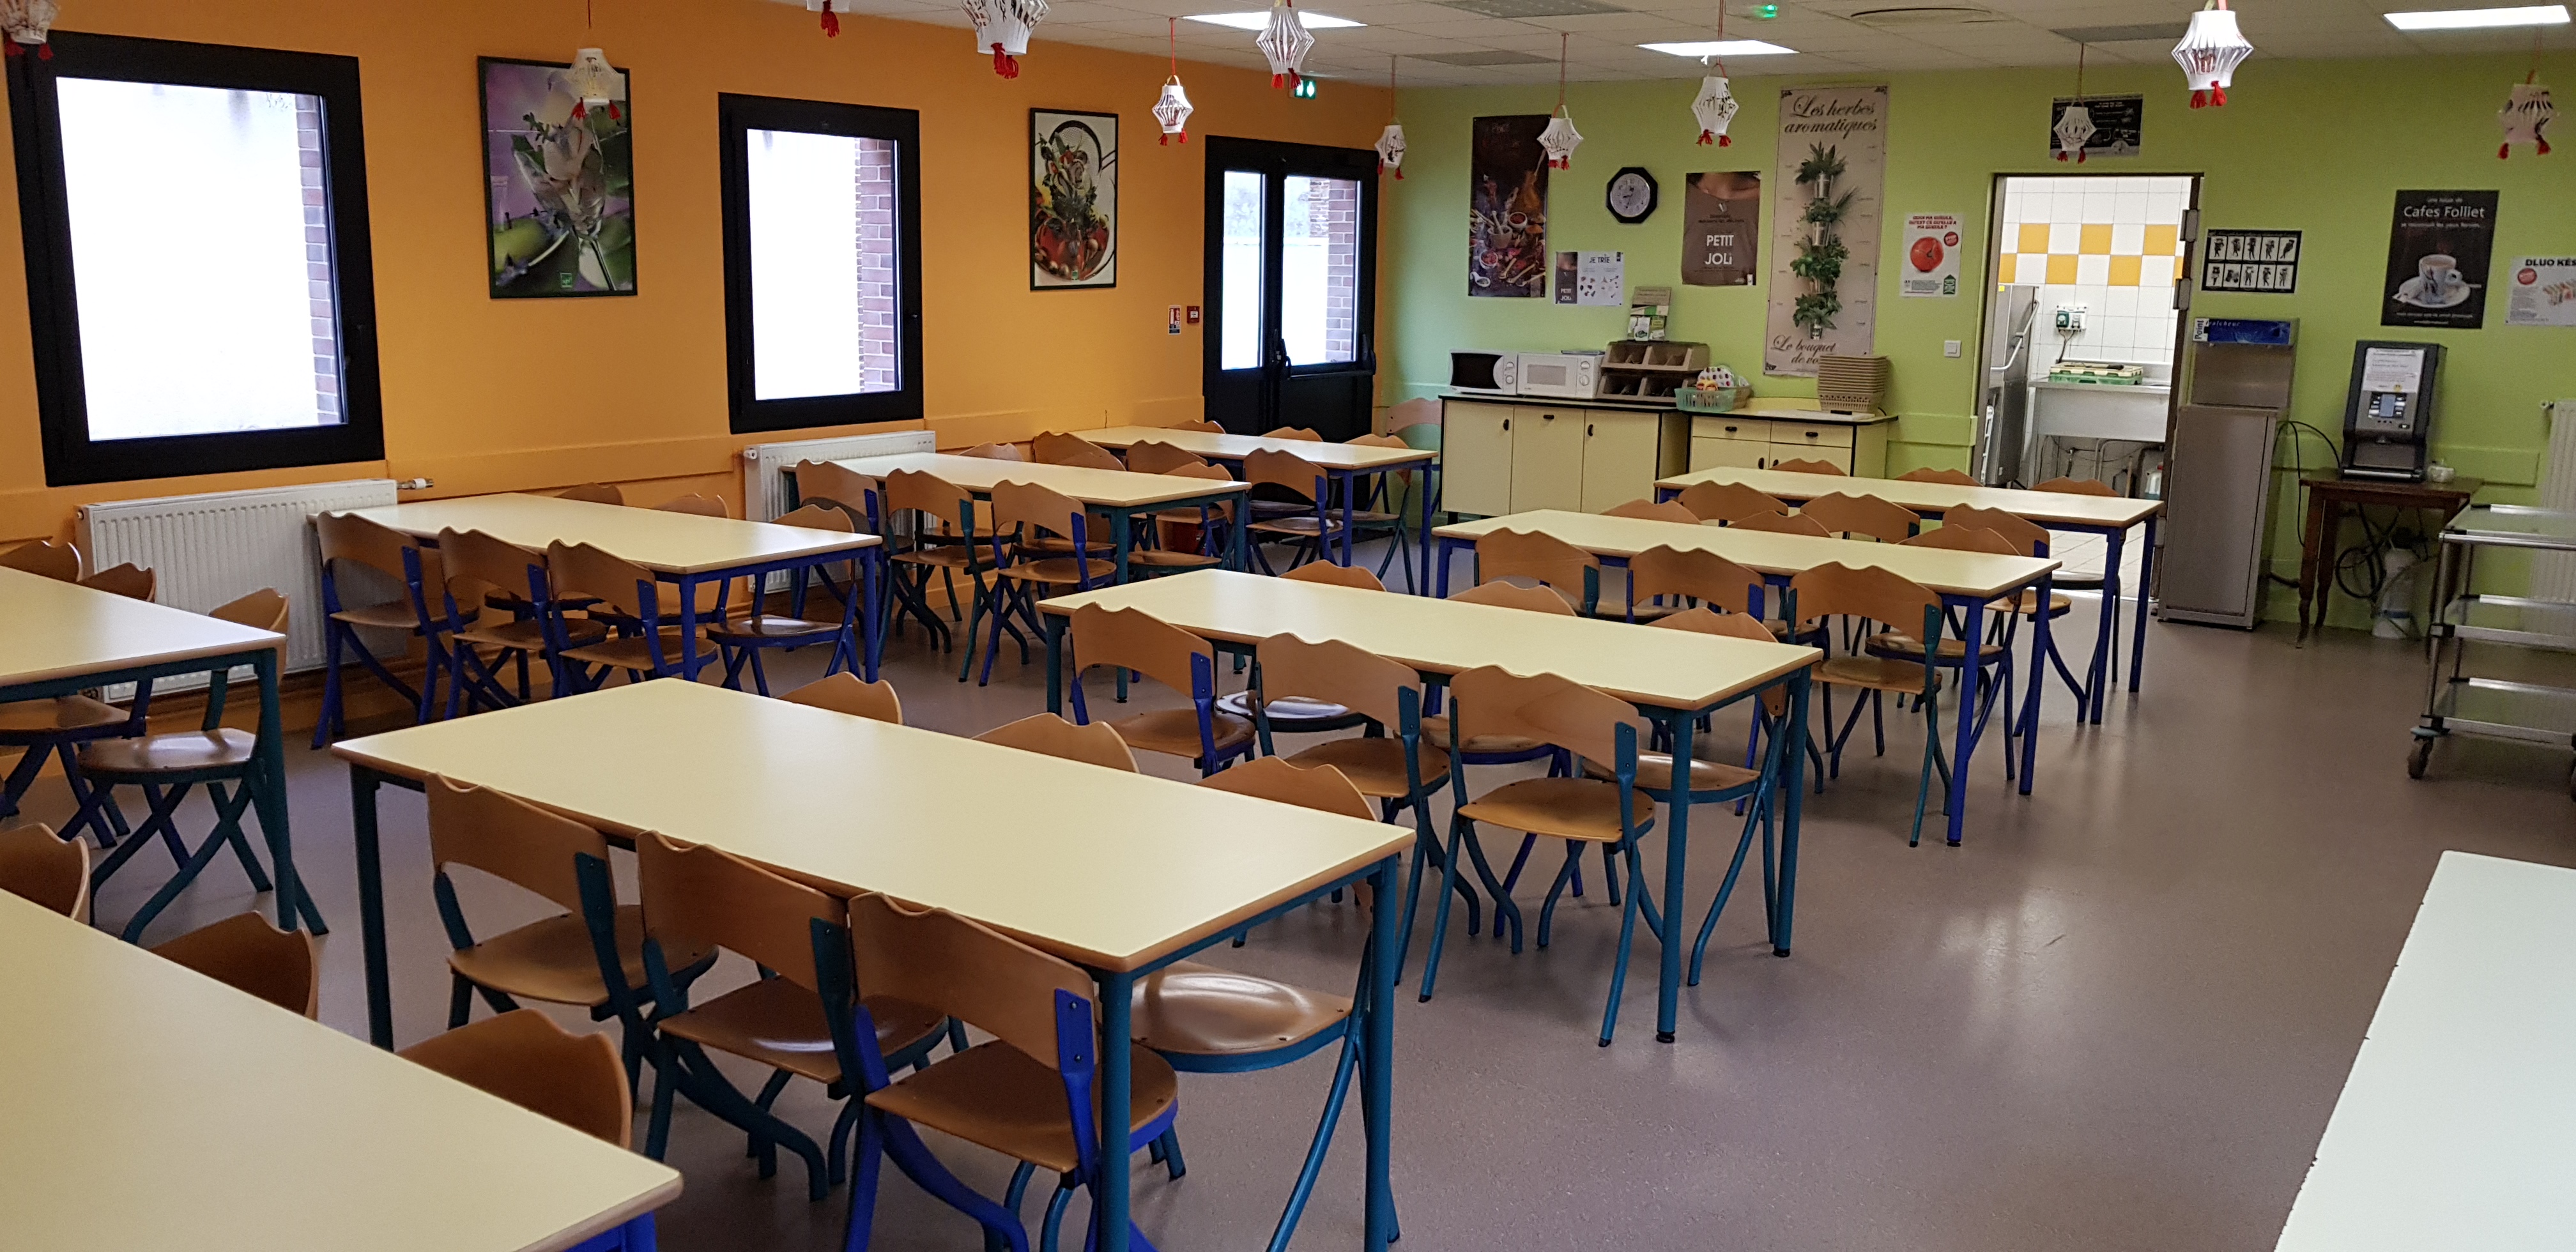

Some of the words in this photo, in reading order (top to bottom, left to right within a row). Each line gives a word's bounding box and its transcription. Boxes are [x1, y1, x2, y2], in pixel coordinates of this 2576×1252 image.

[1790, 96, 1825, 118] Les
[1827, 98, 1875, 116] herbes
[1784, 119, 1877, 139] aromatiques
[2404, 205, 2440, 218] Cafes
[2444, 206, 2485, 218] Folliet
[1706, 234, 1734, 247] PETIT
[2194, 320, 2204, 339] Point
[1771, 334, 1793, 351] Le
[1796, 339, 1836, 358] bouquet
[1791, 352, 1802, 363] de
